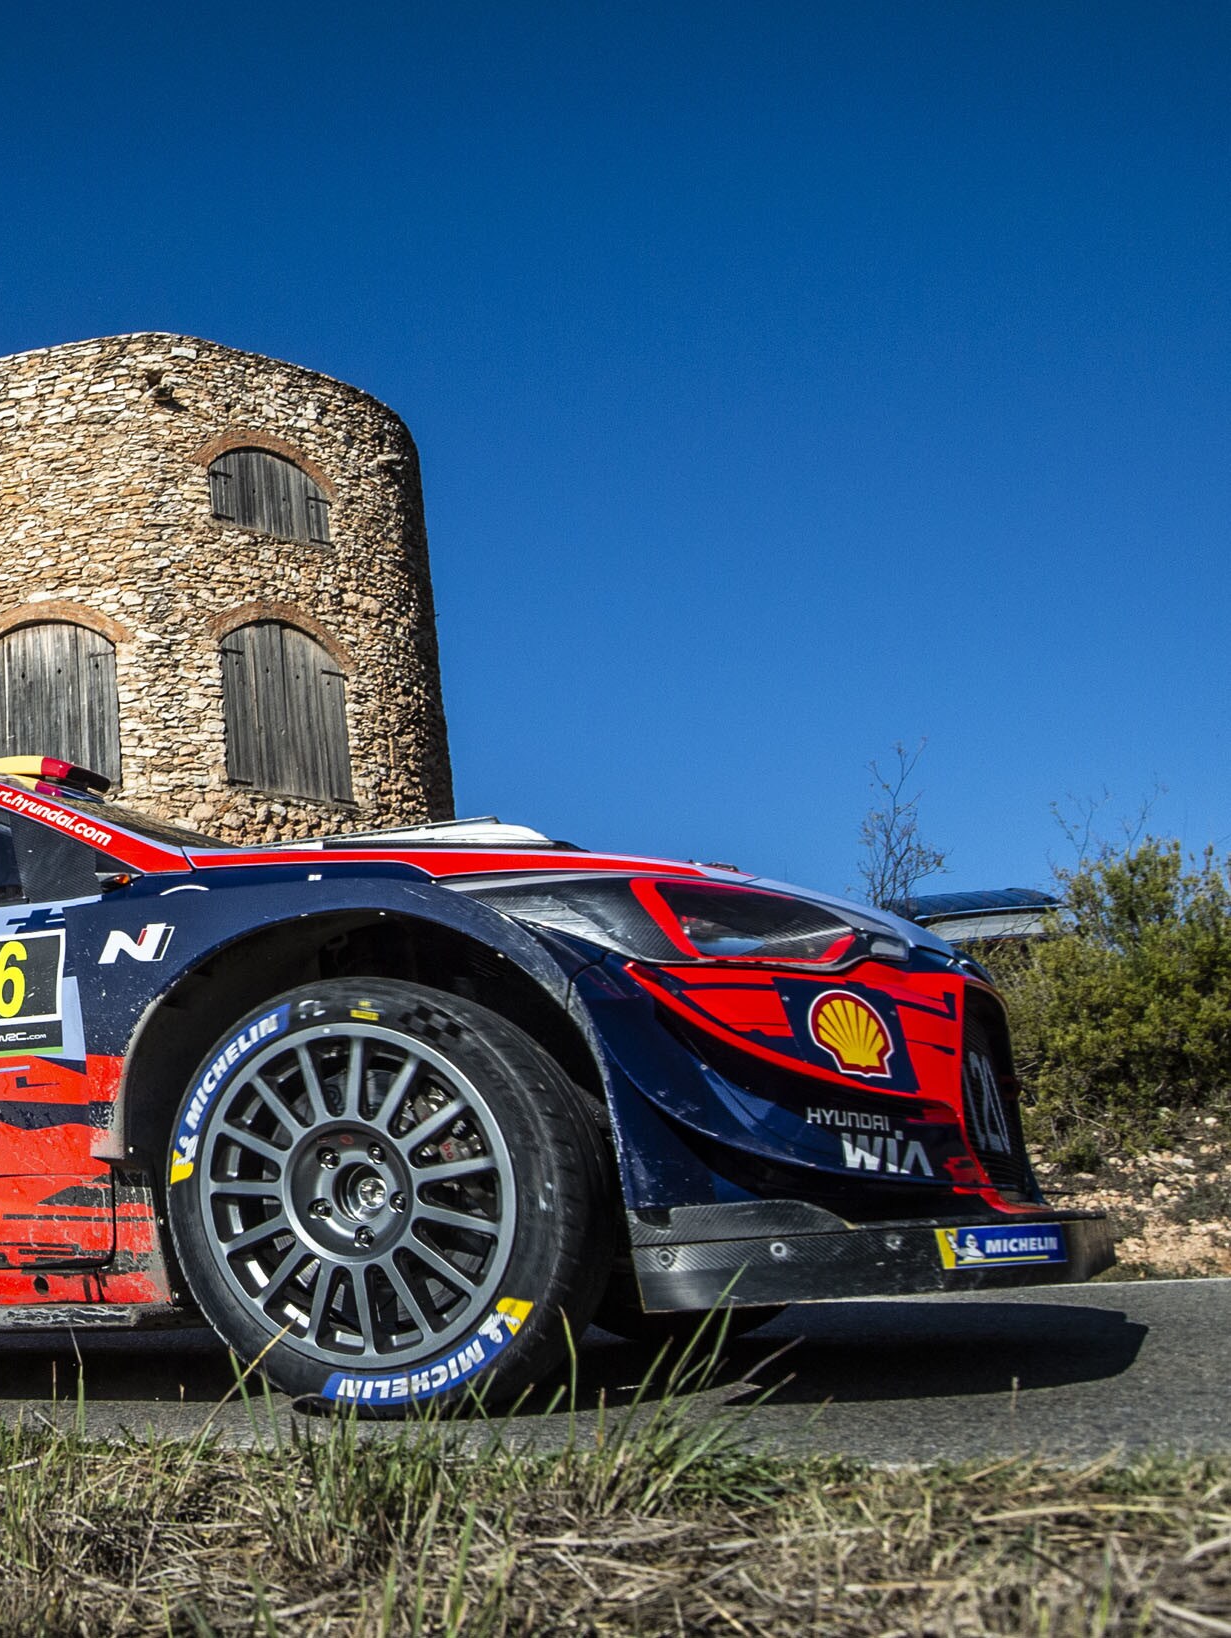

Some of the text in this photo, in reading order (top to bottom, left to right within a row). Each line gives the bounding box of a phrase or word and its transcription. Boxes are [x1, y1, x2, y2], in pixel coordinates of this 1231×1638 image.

[185, 1013, 280, 1131] MICHELIN
[806, 1106, 890, 1132] HYUNDAI
[840, 1129, 934, 1177] WIA
[984, 1236, 1059, 1254] MICHELIN
[339, 1341, 486, 1400] MICHELIN
